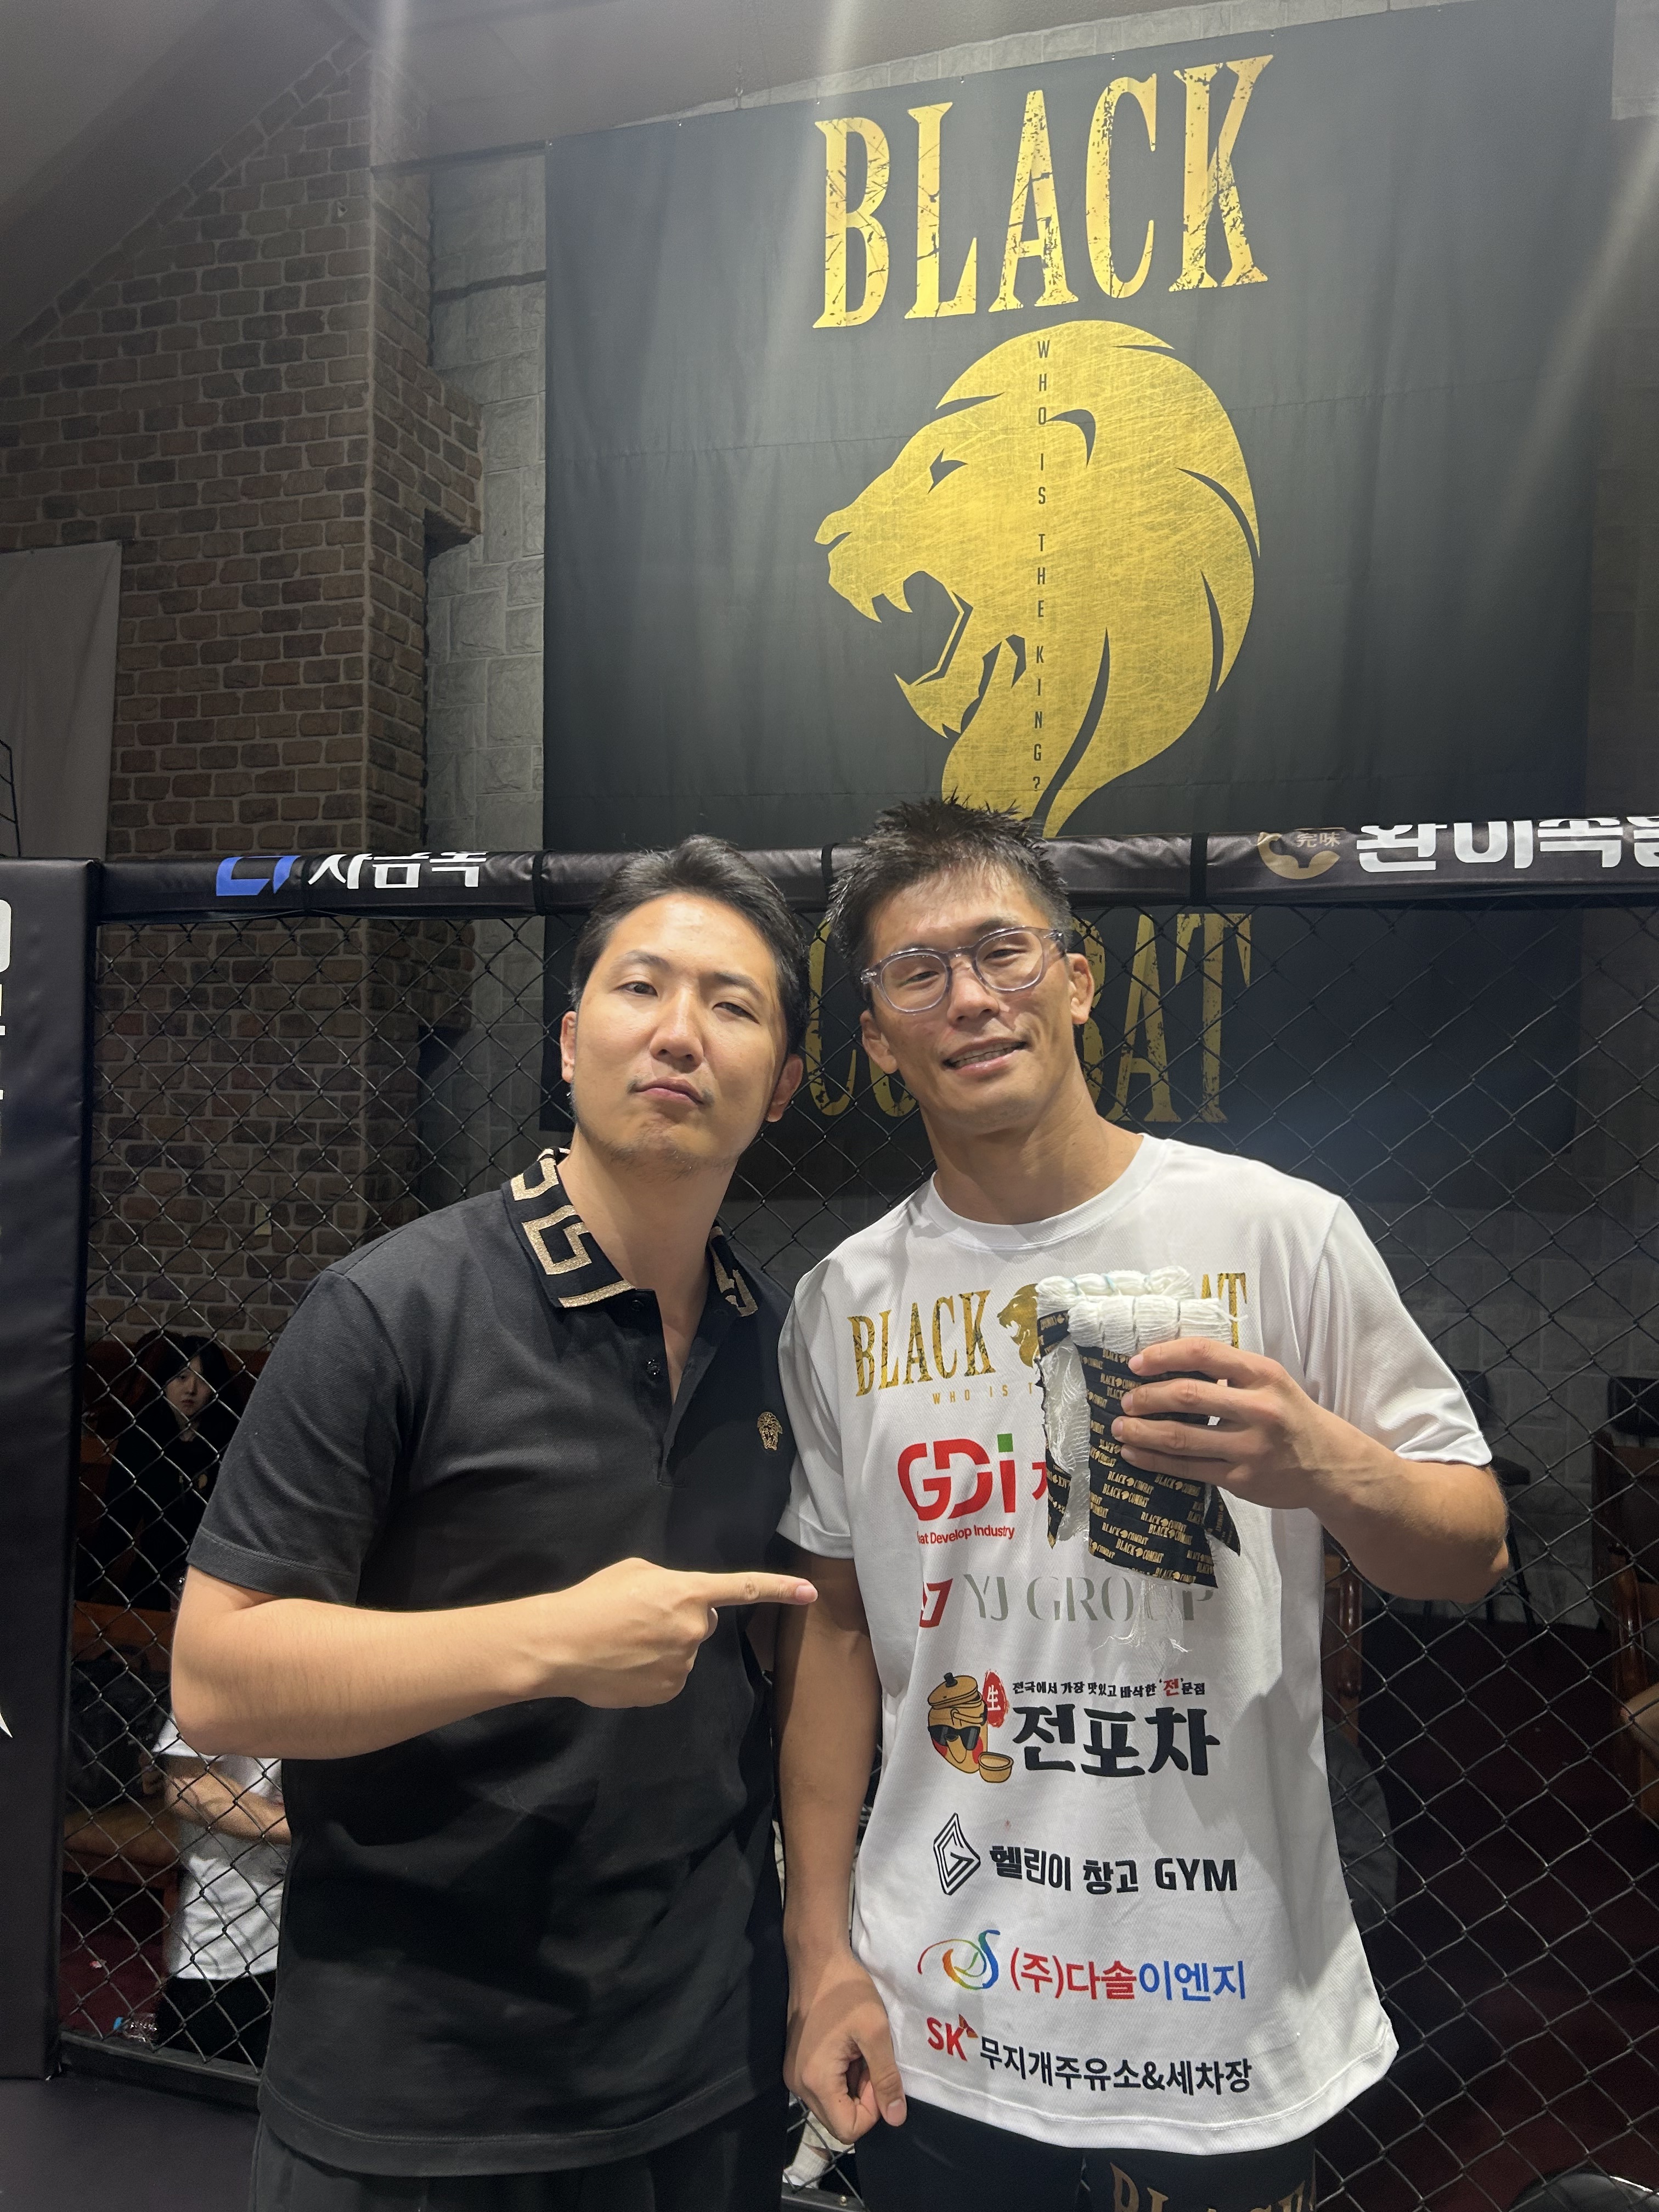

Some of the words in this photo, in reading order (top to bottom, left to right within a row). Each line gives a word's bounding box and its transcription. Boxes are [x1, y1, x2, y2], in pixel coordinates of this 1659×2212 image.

[813, 55, 1273, 328] BLACK
[1037, 340, 1049, 425] WHO
[1038, 453, 1046, 505] IS
[1037, 534, 1046, 618] THE
[1032, 646, 1045, 792] KING?
[847, 1290, 996, 1397] BLACK
[933, 1389, 970, 1405] WHO
[990, 1384, 1008, 1398] IS
[1102, 1483, 1122, 1499] BLACK
[1128, 1492, 1150, 1508] COMBAT
[1107, 1470, 1128, 1485] BLACK
[1155, 1474, 1176, 1490] BLACK
[930, 1527, 972, 1544] Develop
[973, 1525, 1015, 1540] Industry
[1102, 1522, 1121, 1537] BLACK
[1141, 1511, 1161, 1525] BLACK
[1148, 1523, 1169, 1538] BLACK
[1116, 1538, 1136, 1556] BLACK
[1142, 1549, 1165, 1564] COMBAT
[963, 1573, 1008, 1621] YJ
[1026, 1576, 1215, 1622] GROP
[987, 1684, 1001, 1711] 生
[1012, 1680, 1058, 1694] 전국에서
[1060, 1681, 1086, 1694] 가장
[1087, 1681, 1116, 1697] 맛있고
[1120, 1683, 1157, 1699] 바삭한
[1012, 1703, 1221, 1778] 전포차
[989, 1845, 1071, 1891] 헬린이
[1083, 1860, 1139, 1895] 창고
[1154, 1858, 1238, 1891] GYM
[1011, 1947, 1246, 2001] (주)다솔이엔지
[927, 2016, 968, 2062] SK
[979, 2036, 1252, 2096] 무지개주유소&세차장
